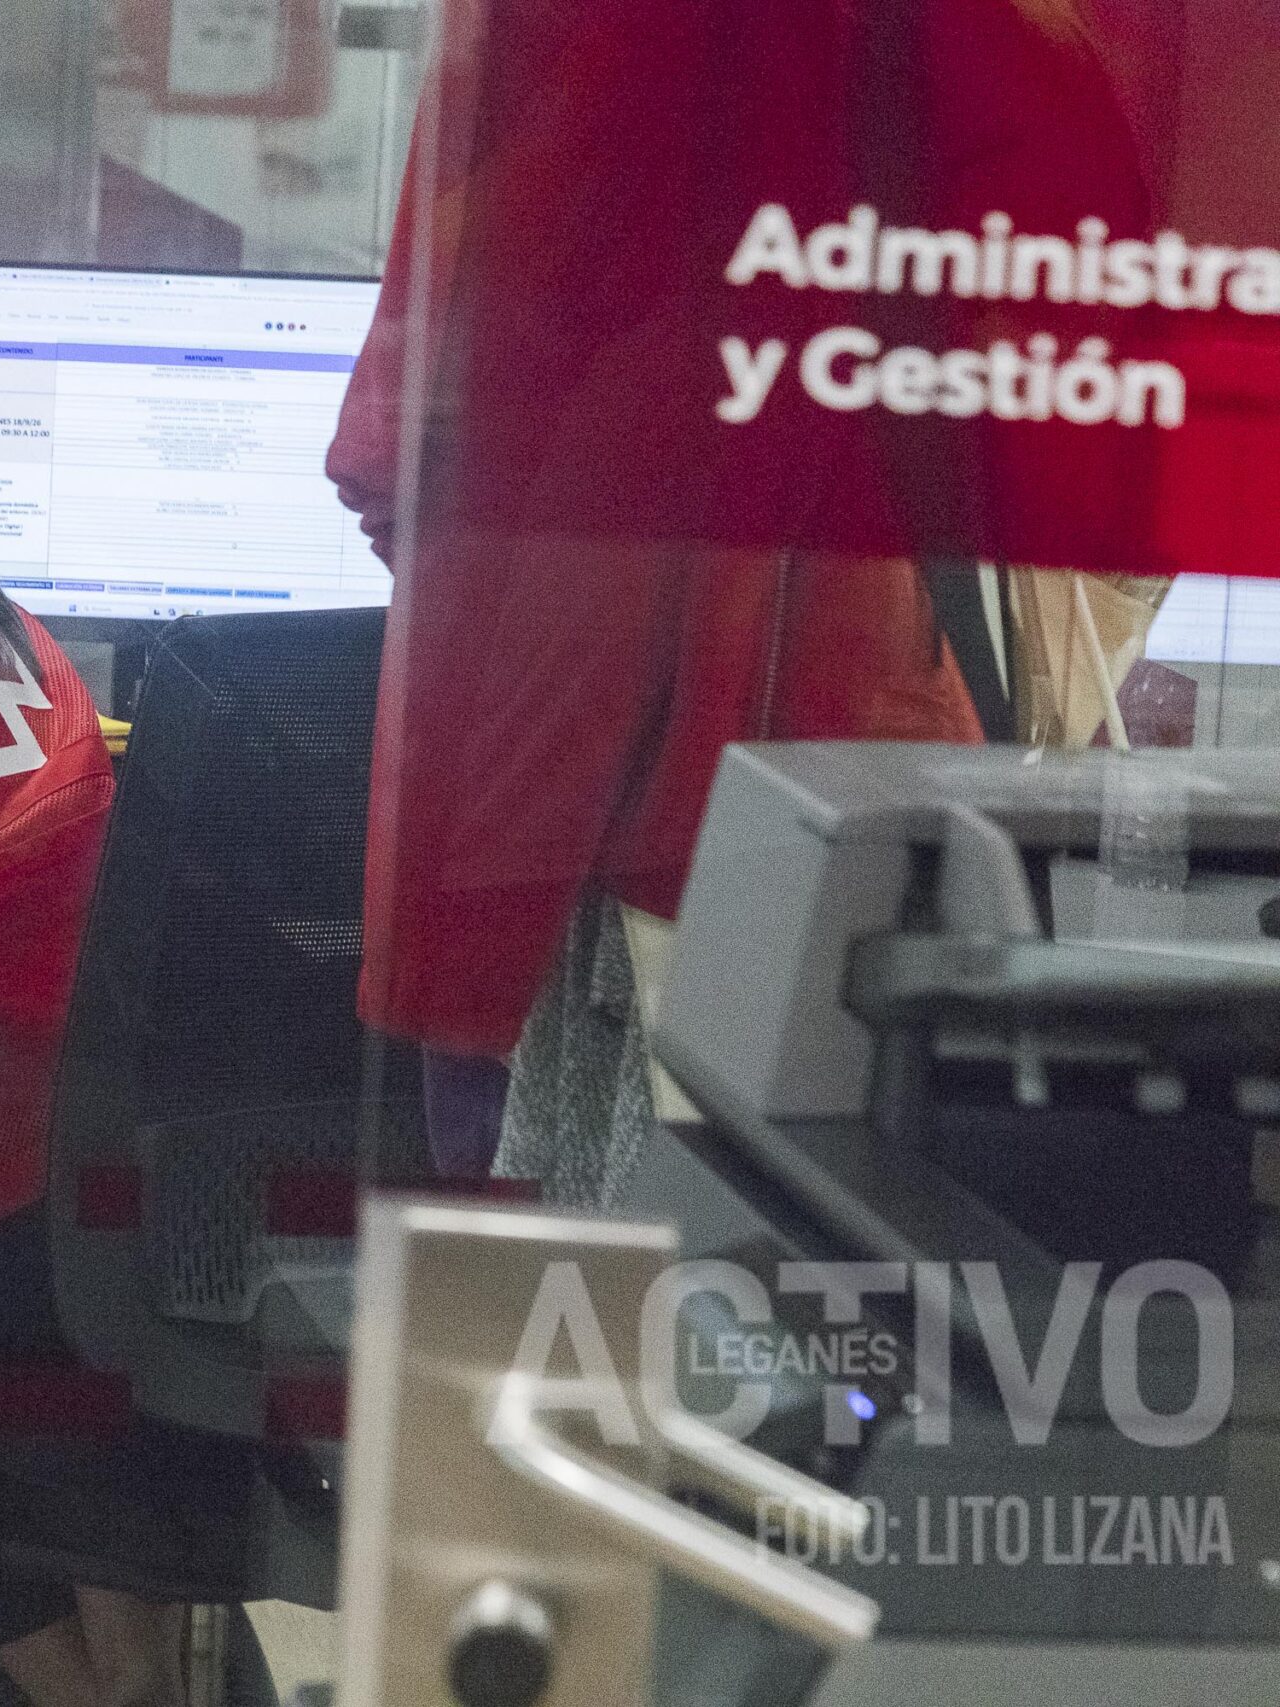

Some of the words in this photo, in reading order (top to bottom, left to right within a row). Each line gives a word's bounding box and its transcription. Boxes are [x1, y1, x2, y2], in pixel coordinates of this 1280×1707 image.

[716, 336, 789, 426] y
[799, 326, 1187, 430] Gestión
[1, 429, 21, 437] 09:30
[30, 430, 51, 438] 12:00
